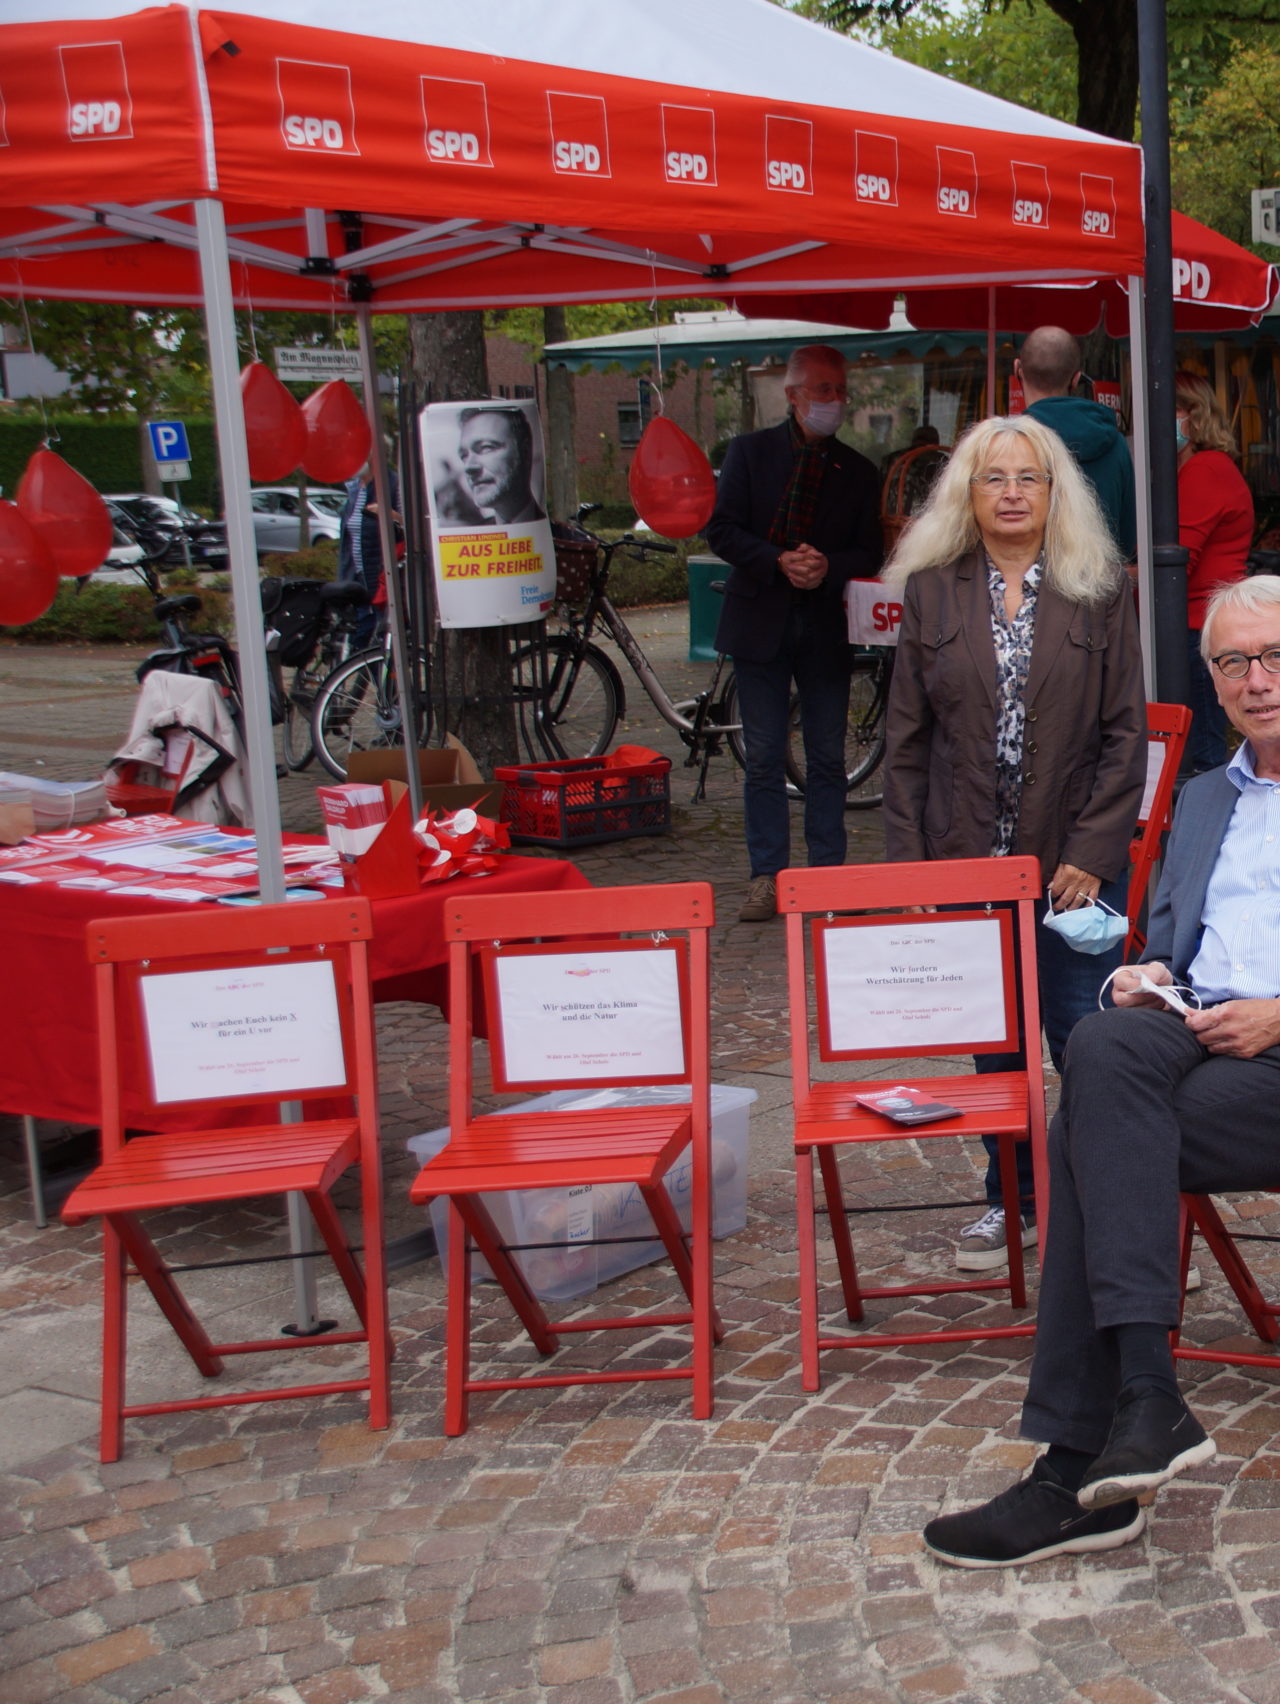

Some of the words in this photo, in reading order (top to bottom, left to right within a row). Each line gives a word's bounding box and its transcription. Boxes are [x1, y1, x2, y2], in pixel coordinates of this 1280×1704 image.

[71, 103, 121, 135] SPD
[286, 116, 343, 149] SPD
[428, 130, 479, 161] SPD
[555, 141, 601, 172] SPD
[666, 152, 708, 180] SPD
[768, 160, 805, 189] SPD
[857, 174, 891, 201] SPD
[939, 186, 970, 212] SPD
[1014, 200, 1043, 225] SPD
[1083, 209, 1110, 234] SPD
[1172, 258, 1210, 299] PD
[157, 426, 178, 457] P
[459, 544, 492, 557] AUS
[499, 541, 531, 555] LIEBE
[446, 564, 480, 577] ZUR
[872, 602, 903, 632] SP
[866, 976, 924, 985] Wertschätzung
[926, 975, 938, 983] für
[940, 974, 963, 982] Jeden
[907, 965, 937, 974] fordern
[543, 1003, 558, 1011] Wir
[560, 1002, 595, 1011] schützen
[562, 1013, 577, 1021] und
[191, 1021, 208, 1029] Wir
[246, 1015, 267, 1024] Euch
[270, 1014, 288, 1022] kein
[290, 1013, 297, 1022] X
[218, 1028, 231, 1037] für
